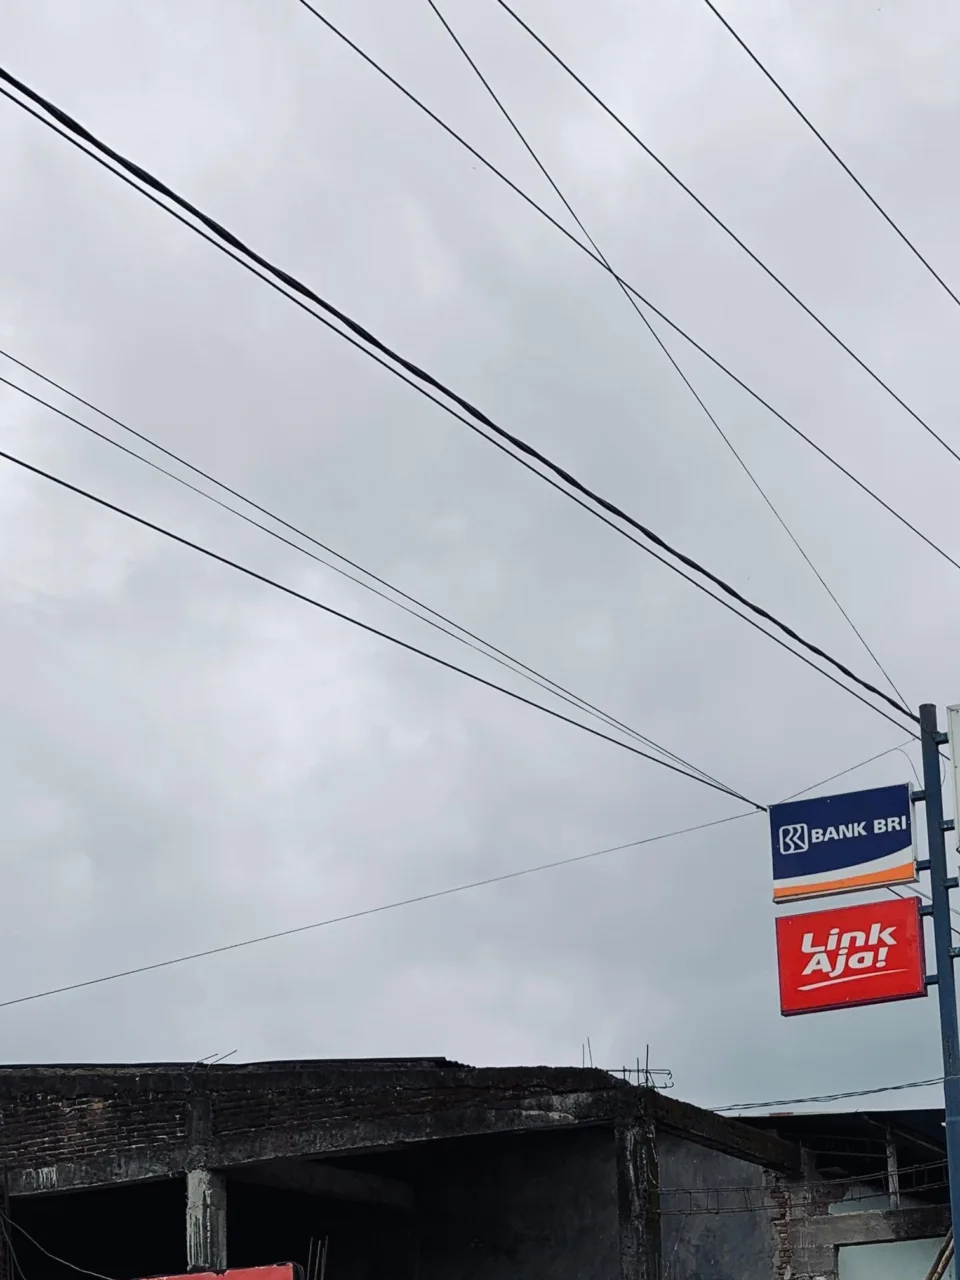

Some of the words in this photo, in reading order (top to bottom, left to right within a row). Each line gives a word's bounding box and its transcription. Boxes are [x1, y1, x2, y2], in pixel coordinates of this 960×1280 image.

[811, 821, 867, 843] BANK
[873, 815, 907, 834] BRI
[801, 922, 897, 954] Link
[801, 946, 889, 978] Aja!
